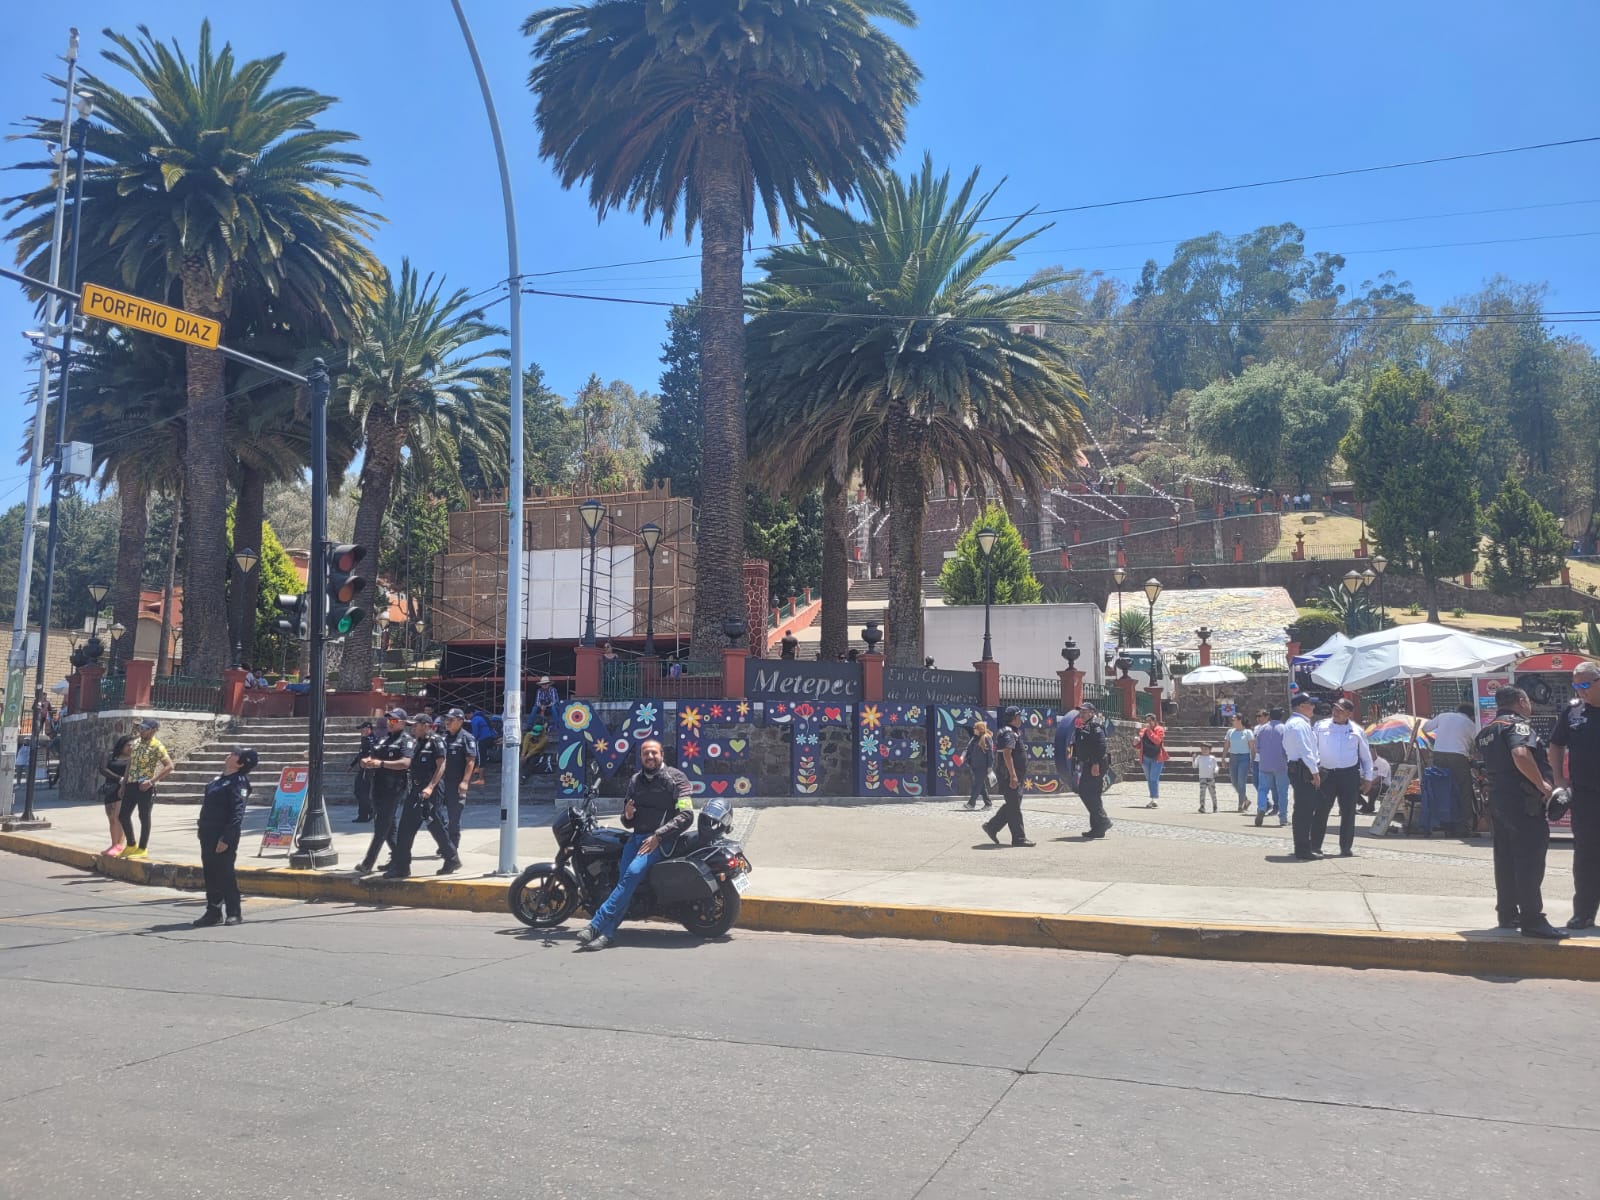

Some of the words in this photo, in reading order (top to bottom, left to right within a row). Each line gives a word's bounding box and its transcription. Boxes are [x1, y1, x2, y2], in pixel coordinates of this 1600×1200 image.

[90, 292, 168, 329] PORFIRIO
[174, 317, 212, 342] DIAZ
[752, 669, 858, 700] Metepec
[888, 668, 904, 681] En
[908, 670, 919, 682] el
[887, 688, 900, 700] de
[904, 687, 921, 700] los
